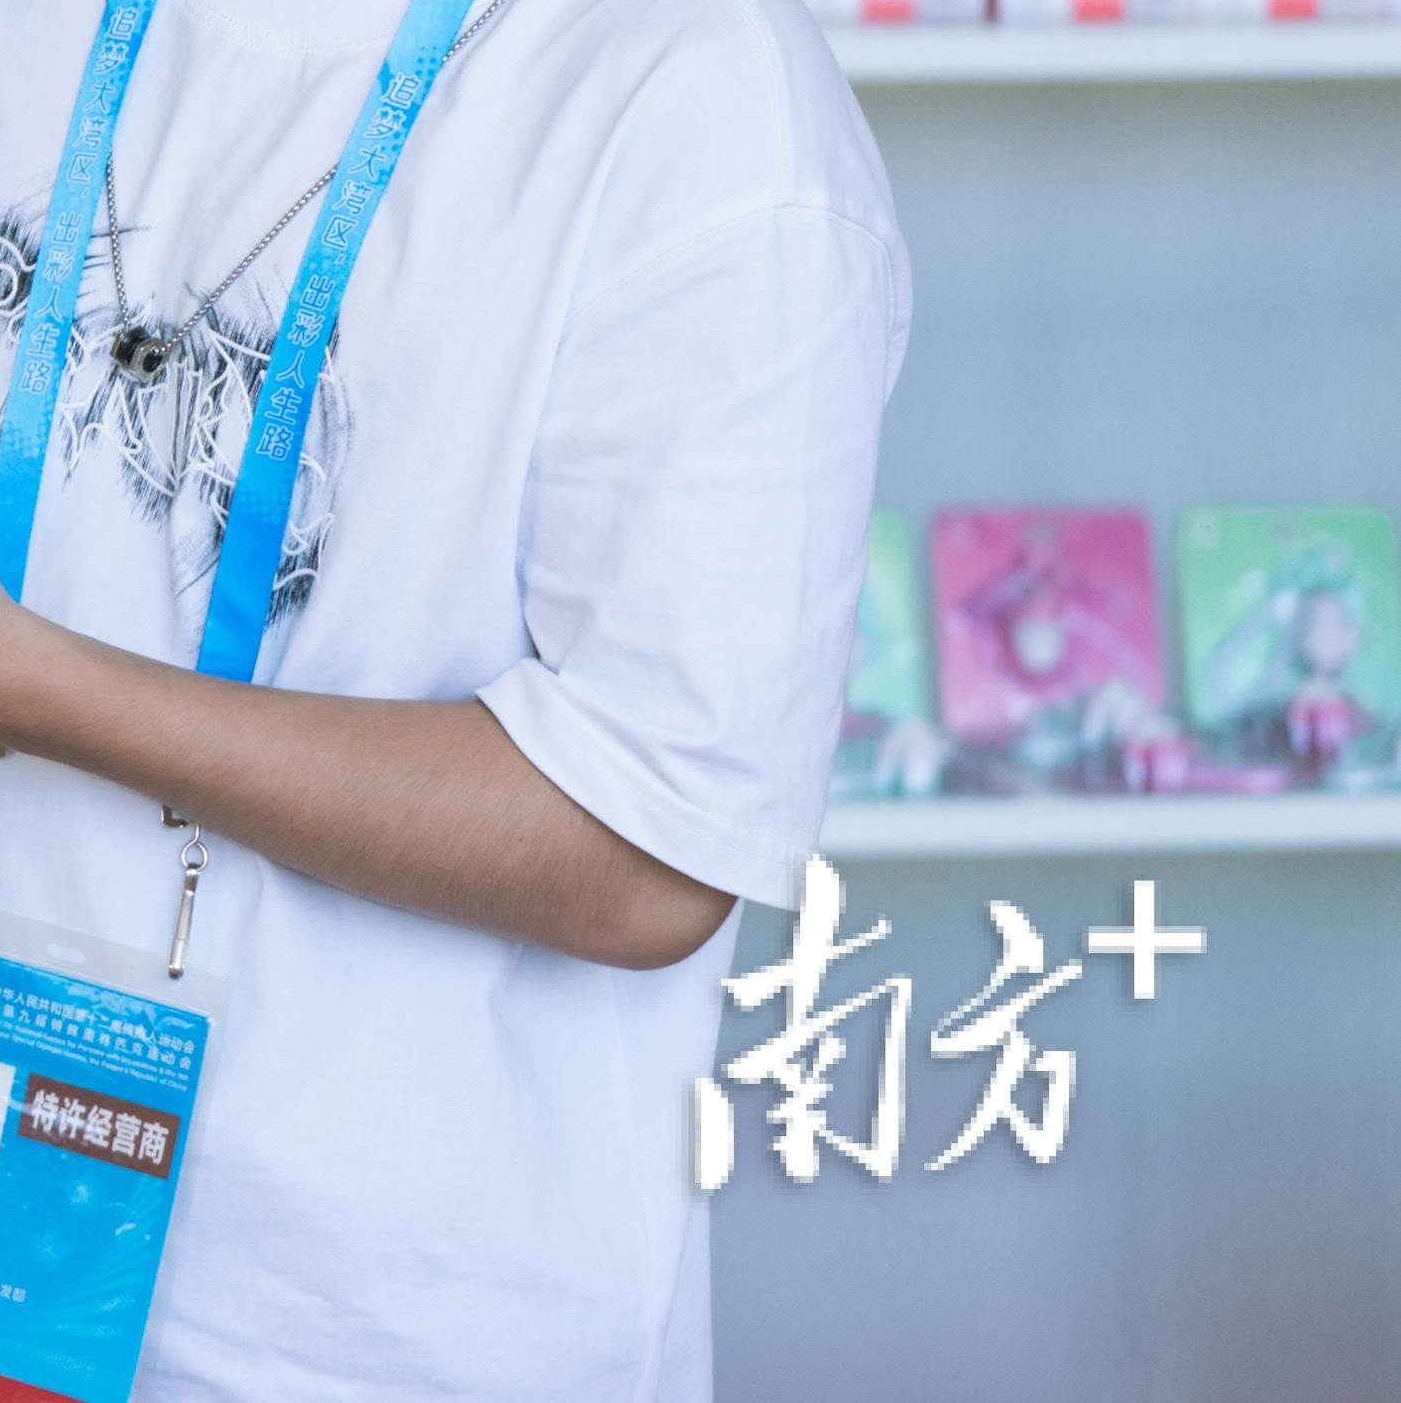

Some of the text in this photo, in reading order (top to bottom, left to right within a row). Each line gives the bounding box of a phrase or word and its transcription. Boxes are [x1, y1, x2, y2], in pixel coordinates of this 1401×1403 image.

[30, 1089, 170, 1165] 特许经营商
